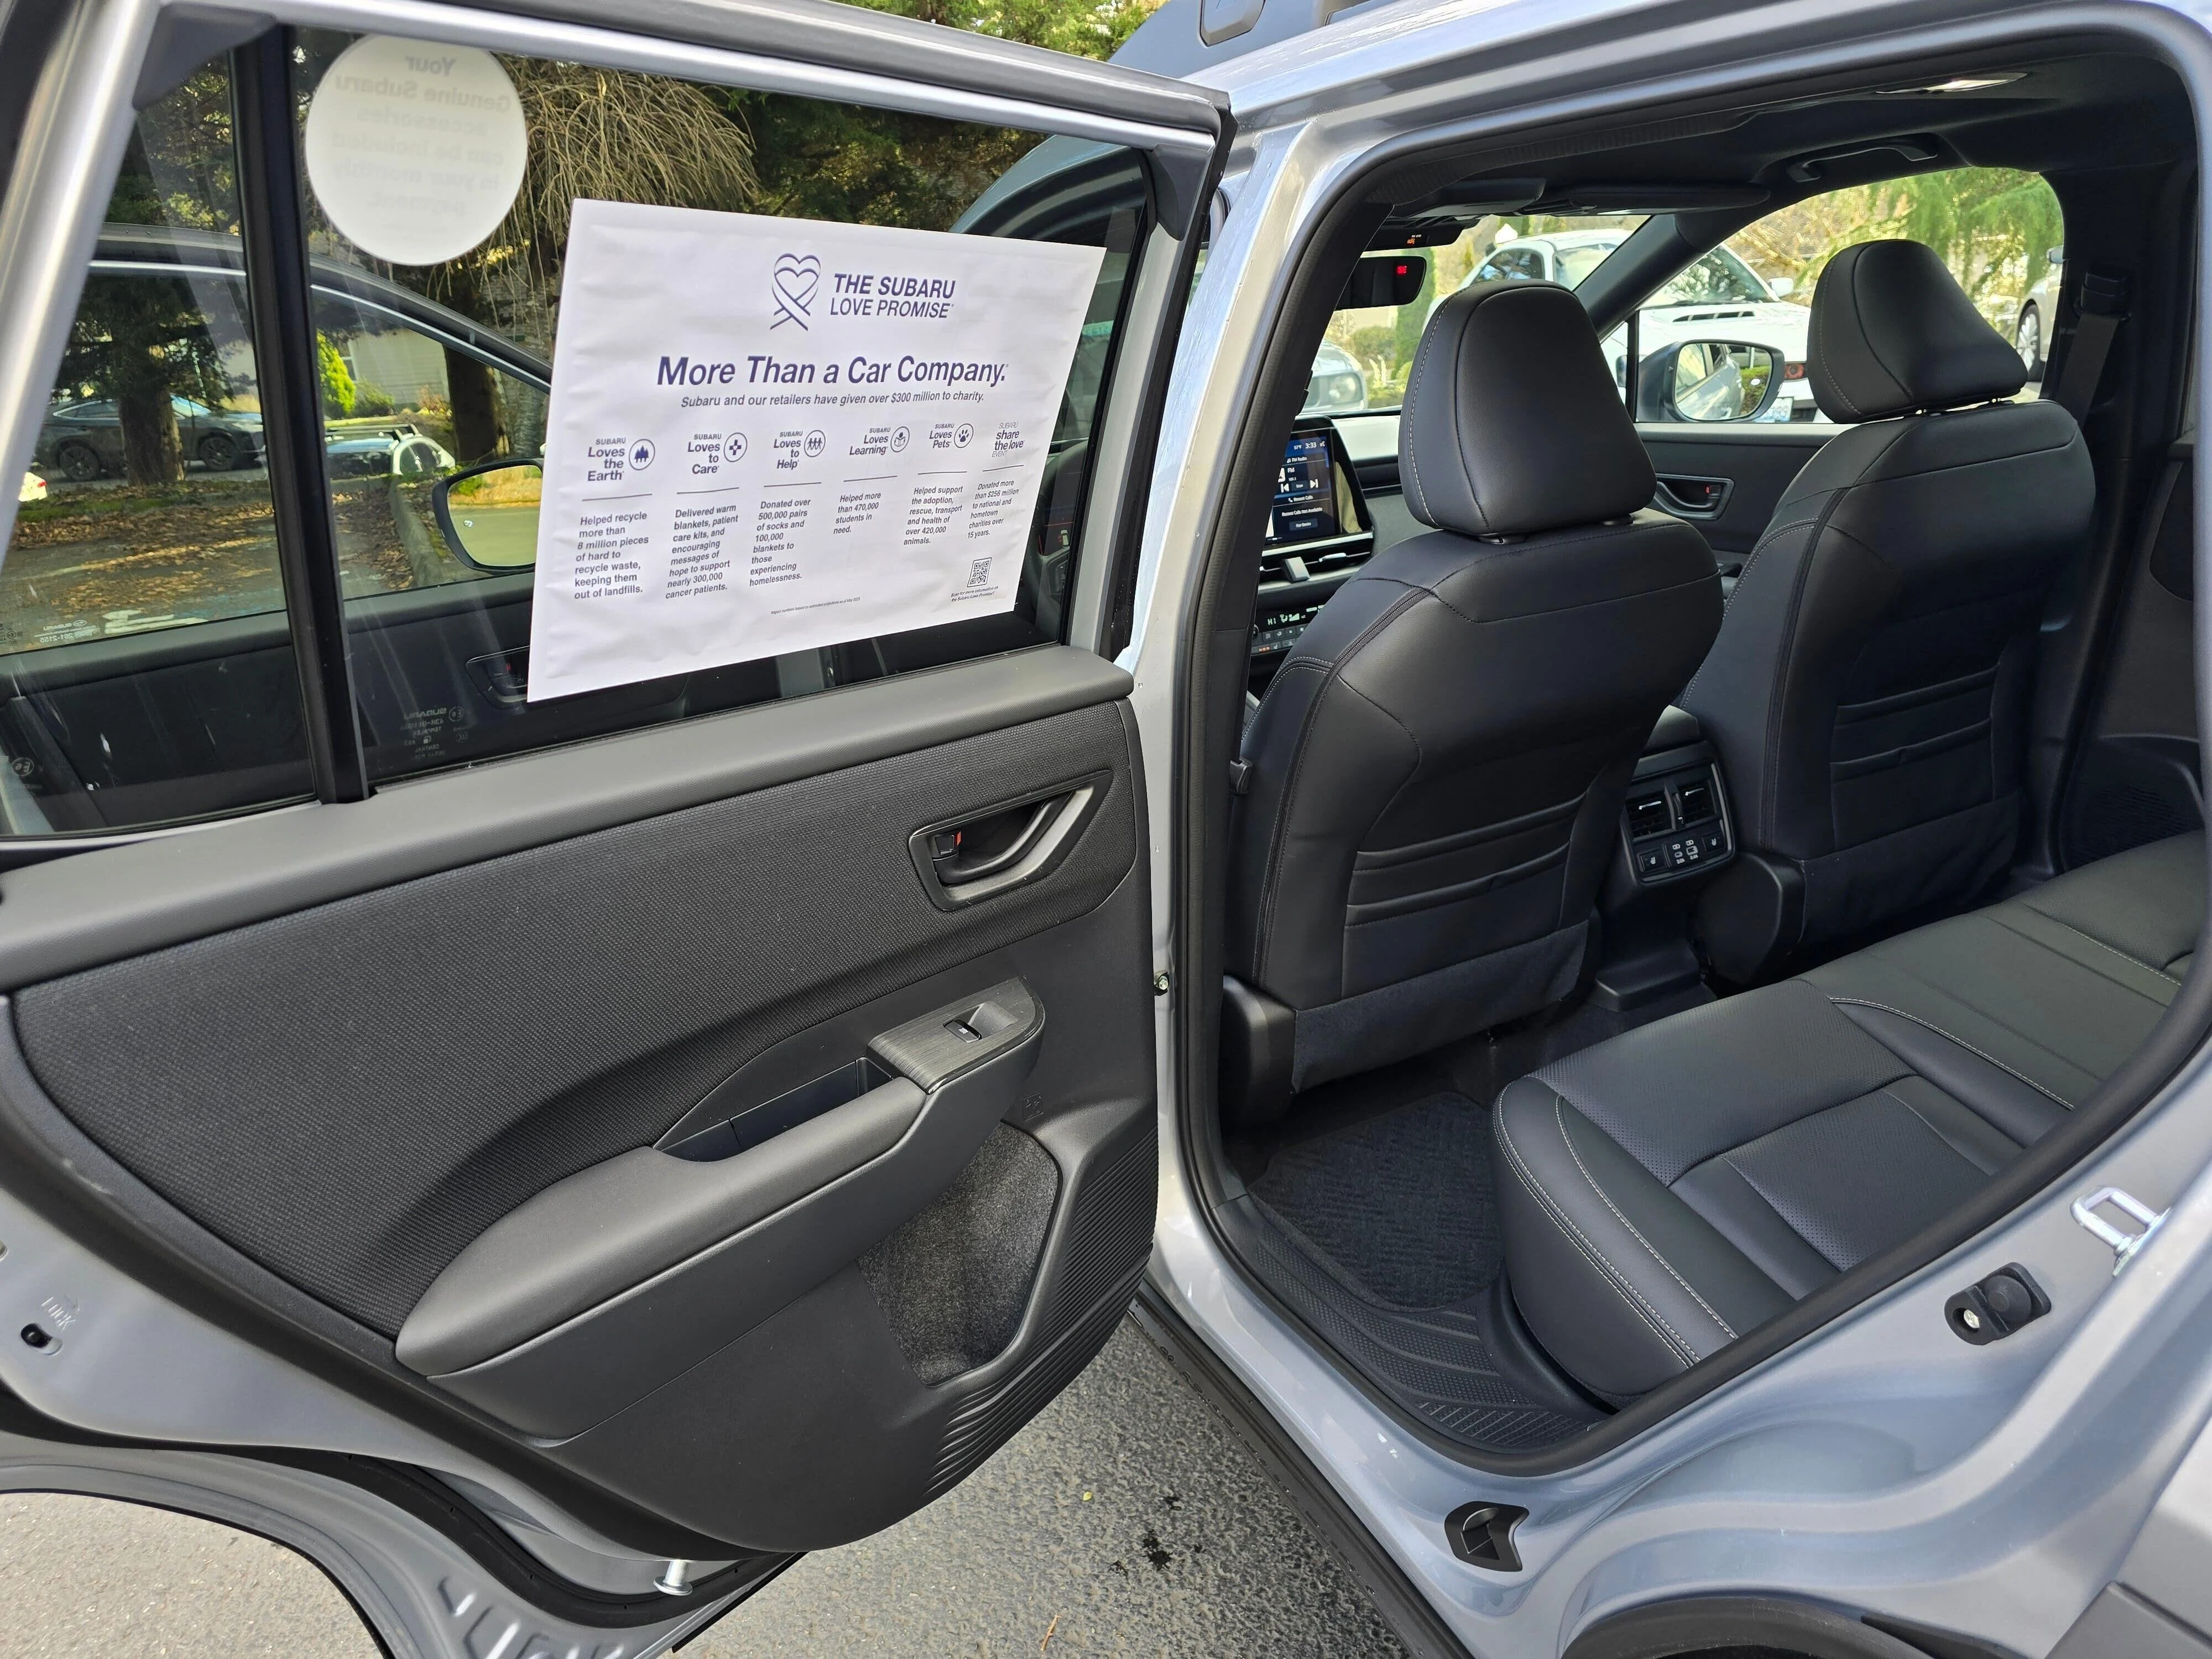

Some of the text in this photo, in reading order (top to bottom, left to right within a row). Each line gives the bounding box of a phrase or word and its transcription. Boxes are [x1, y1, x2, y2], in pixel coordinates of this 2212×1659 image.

[834, 273, 956, 299] THE SUBARU
[830, 298, 874, 316] LOVE
[657, 355, 1009, 388] More Than a Car Company.
[681, 390, 984, 408] Subaru and our retailers have given over $300 million to charity.
[863, 435, 889, 444] Loves
[929, 430, 952, 440] Loves
[996, 430, 1020, 440] share
[687, 441, 721, 452] Loves
[773, 439, 801, 448] Loves
[588, 446, 625, 457] Loves
[790, 448, 800, 458] to
[604, 458, 624, 469] the
[708, 453, 719, 463] to
[914, 486, 963, 495] Helped support
[978, 481, 1000, 491] Donated
[760, 499, 793, 509] Donated
[839, 493, 864, 504] Helped
[923, 496, 953, 505] adoption,
[979, 499, 1001, 508] national
[675, 505, 736, 518] Delivered warm
[854, 502, 879, 512] 470,000
[935, 504, 962, 514] transport
[580, 511, 647, 526] Helped recycle
[758, 509, 808, 521] 500,000 pairs
[836, 514, 864, 524] students
[971, 510, 998, 519] hometown
[674, 514, 738, 530] blankets, patient
[757, 519, 805, 531] of socks and
[969, 519, 991, 529] charities
[579, 526, 625, 538] more than
[693, 531, 708, 540] kits,
[711, 527, 725, 537] and
[833, 525, 851, 534] need.
[922, 526, 946, 534] 420,000
[974, 530, 990, 539] years.
[586, 539, 617, 549] million
[619, 537, 649, 548] pieces
[755, 533, 784, 542] 100,000
[904, 537, 931, 545] animals.
[672, 540, 721, 554] encouraging
[753, 543, 785, 553] blankets
[576, 553, 586, 562] of
[588, 551, 609, 561] hard
[671, 550, 720, 566] messages of
[752, 556, 772, 564] those
[575, 561, 640, 575] recycle waste,
[669, 568, 688, 577] hope
[700, 560, 730, 572] support
[750, 563, 797, 576] experiencing
[575, 573, 637, 587] keeping them
[667, 572, 723, 588] nearly 300,000
[749, 573, 802, 587] homelessness.
[574, 585, 643, 599] out of landfills.
[665, 583, 727, 599] cancer patients.
